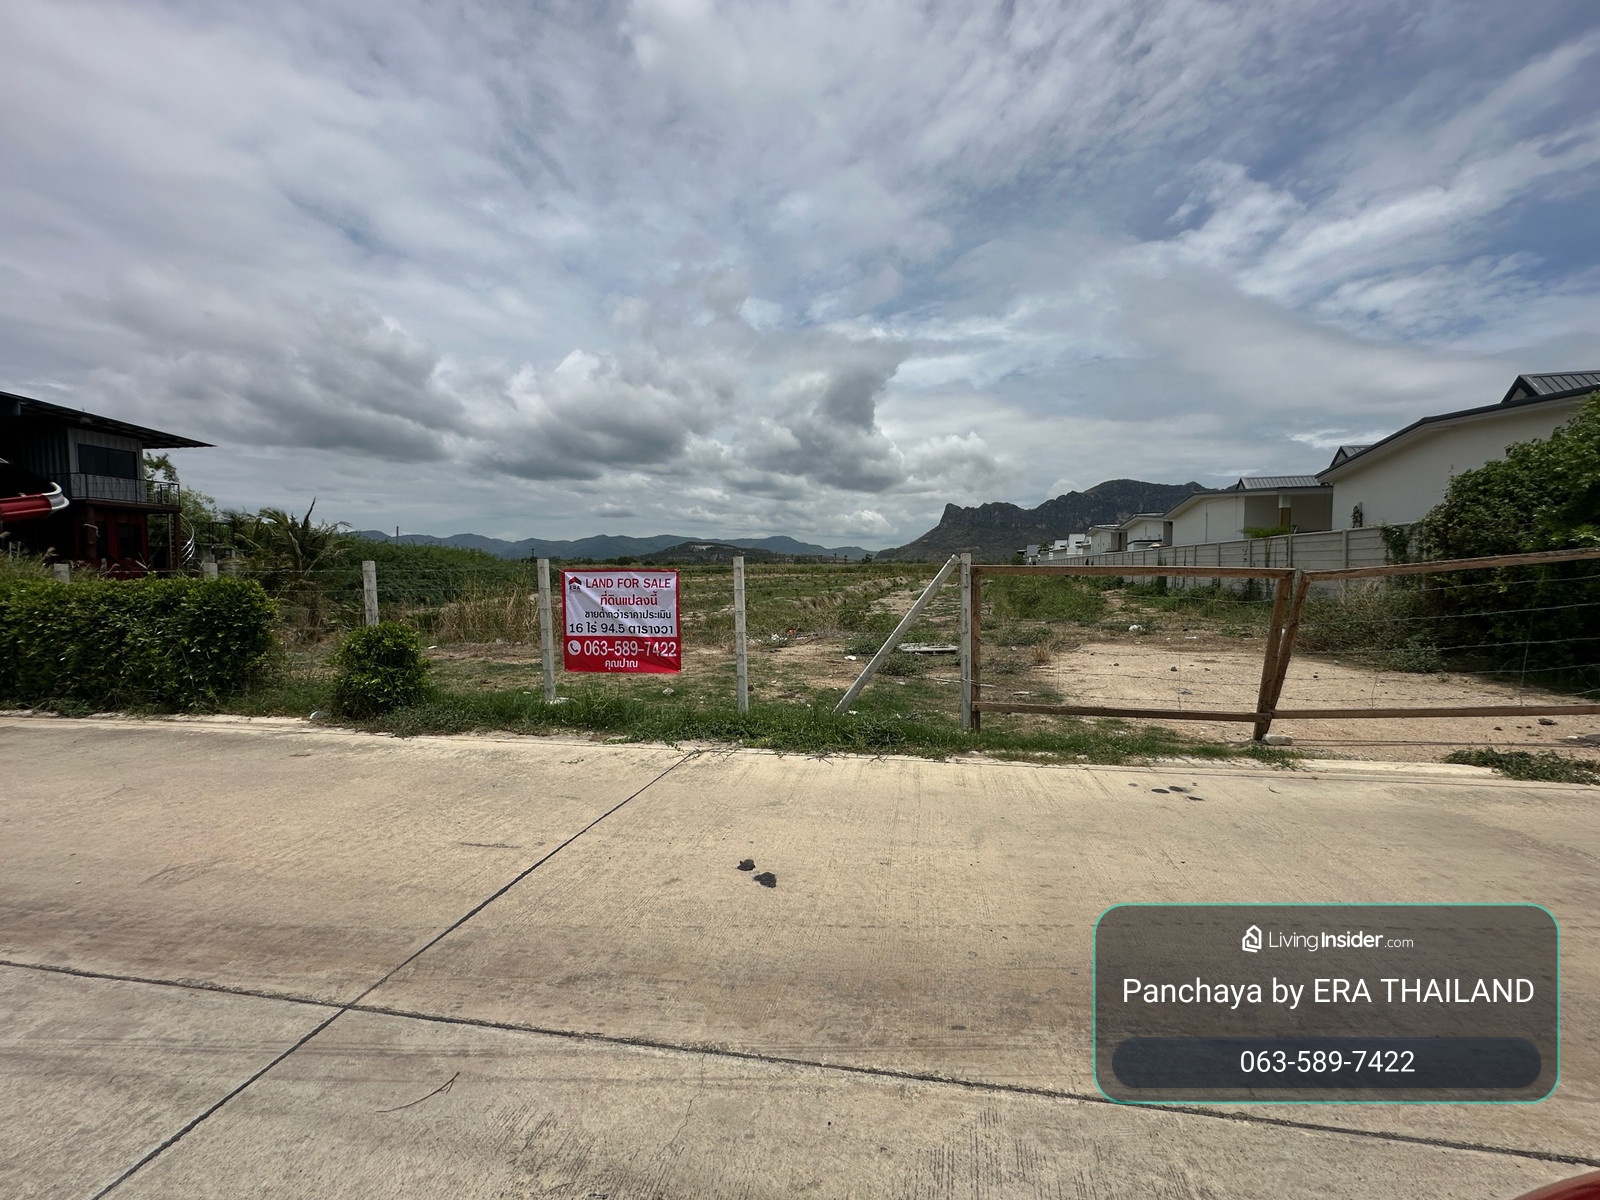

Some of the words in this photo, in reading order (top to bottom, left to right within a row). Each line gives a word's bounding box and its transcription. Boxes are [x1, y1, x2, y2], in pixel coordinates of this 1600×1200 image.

[586, 578, 613, 589] LAND
[617, 578, 639, 589] FOR
[643, 578, 671, 589] SALE
[600, 591, 658, 606] ที่ดินแปลงนี้
[585, 607, 671, 619] ขายต่ำกว่าราคาประเมิน
[569, 623, 583, 633] 16
[586, 621, 598, 633] ไร่
[601, 623, 625, 633] 94.5
[629, 625, 673, 634] ตารางวา
[584, 640, 677, 657] 063-589-7422
[605, 658, 638, 670] คุณปาณ
